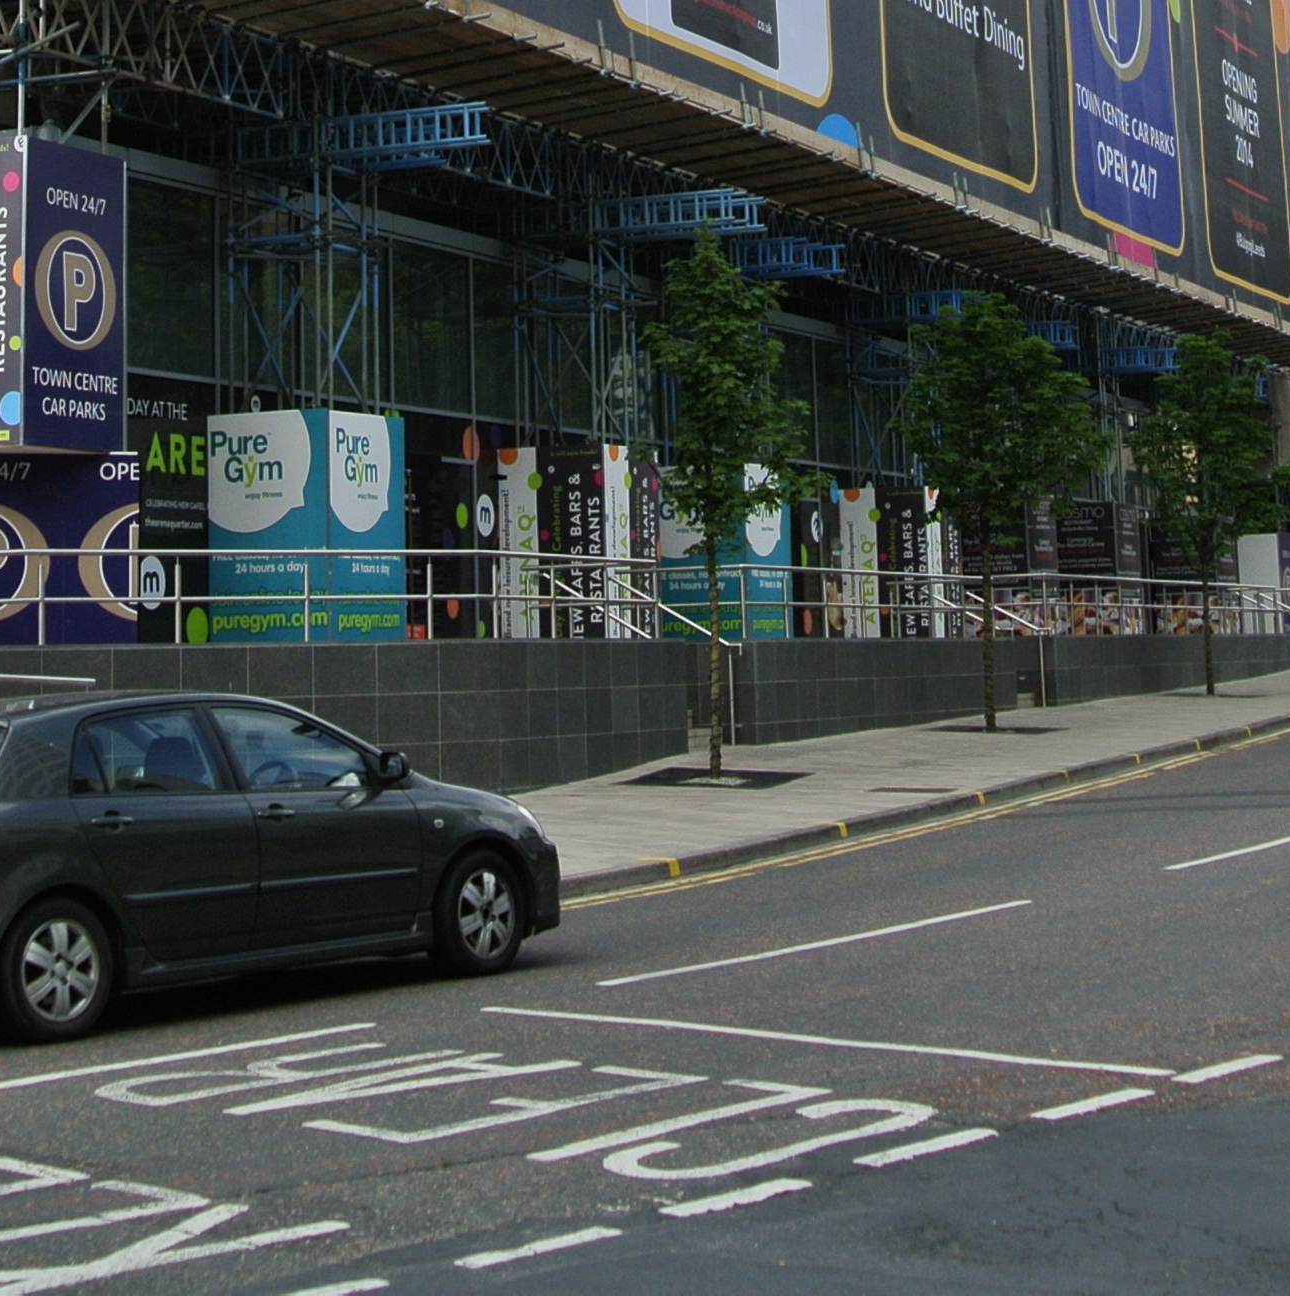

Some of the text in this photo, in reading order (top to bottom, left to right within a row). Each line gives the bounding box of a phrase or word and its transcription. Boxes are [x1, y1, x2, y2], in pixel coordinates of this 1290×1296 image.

[983, 5, 1025, 71] Dining
[1221, 58, 1258, 104] OPENING
[1075, 82, 1175, 157] TOWN CENTRE CAR PARKS
[1224, 94, 1260, 138] SUMMER
[1235, 134, 1254, 168] 2014
[1097, 140, 1157, 200] OPEN 24/7
[46, 187, 106, 216] OPEN 24/7
[63, 251, 96, 331] P
[32, 366, 118, 395] TOWN CENTRE
[42, 396, 107, 422] CAR PARKS
[127, 397, 188, 421] DAY AT THE
[145, 431, 205, 477] ARE
[210, 430, 268, 456] Pure
[335, 427, 369, 455] Pure
[99, 462, 140, 482] OPE
[224, 456, 283, 488] Gym
[344, 456, 378, 487] Gym
[244, 492, 261, 500] enjoy
[568, 473, 582, 536] BARS &
[145, 516, 203, 531] thearenaquarter.com
[902, 509, 914, 558] BARS &
[235, 561, 305, 574] 24 hours a day
[361, 562, 375, 574] hours
[338, 612, 400, 633] puregym.com
[95, 1043, 936, 1180] CLEAR
